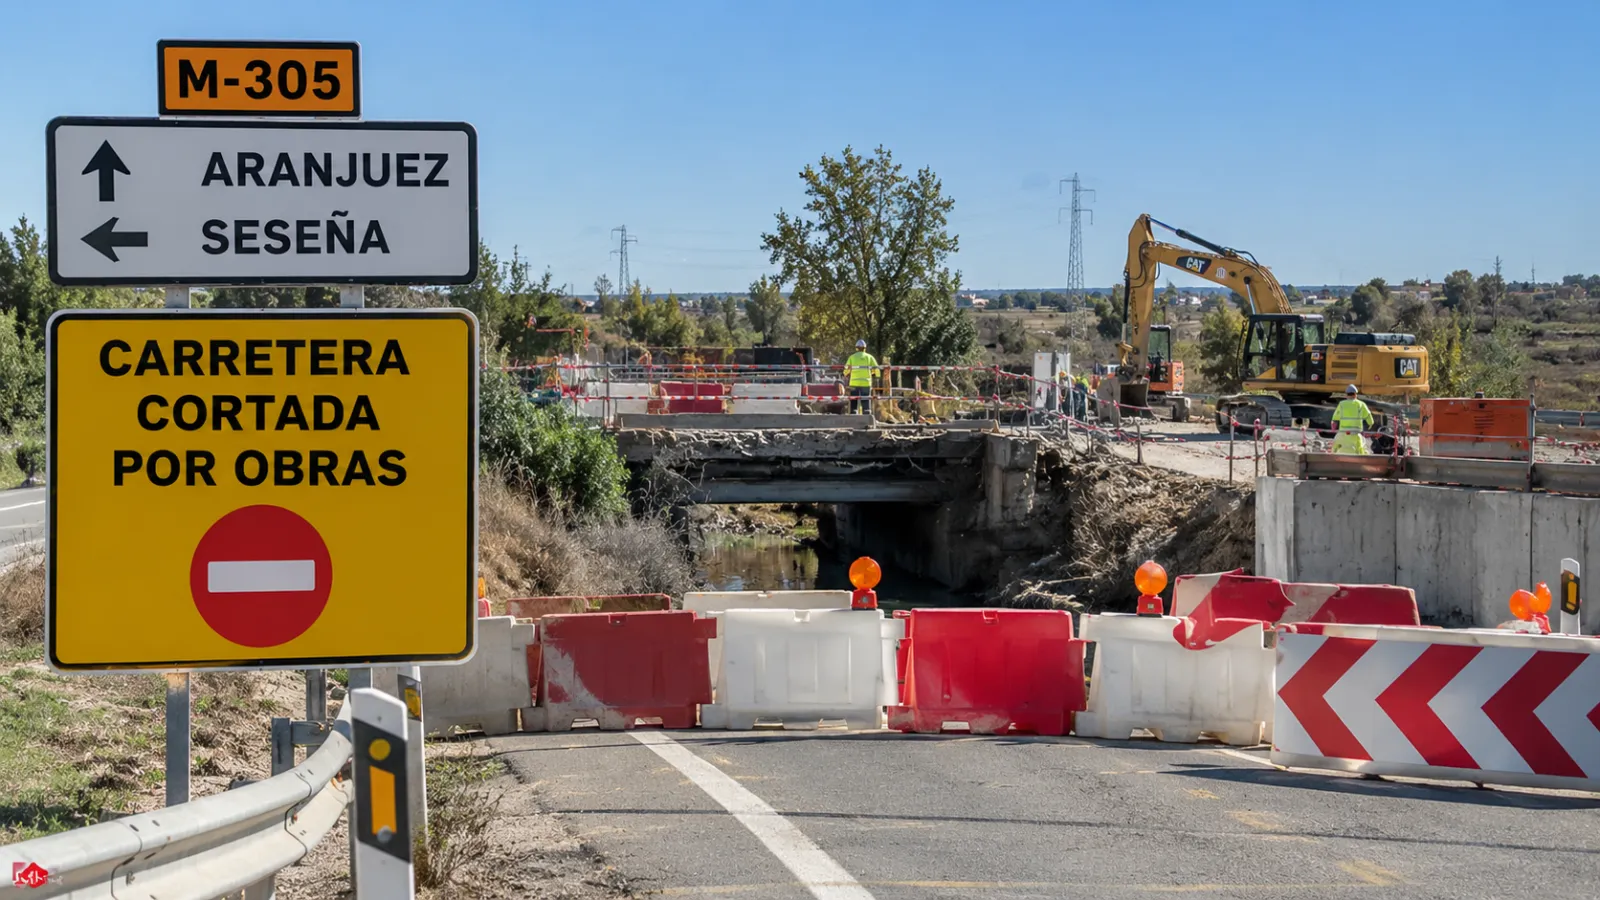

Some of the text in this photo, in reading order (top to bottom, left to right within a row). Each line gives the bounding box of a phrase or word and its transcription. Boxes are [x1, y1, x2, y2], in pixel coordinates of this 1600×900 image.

[178, 58, 341, 102] M-305
[200, 151, 450, 188] ARANJUEZ
[201, 209, 391, 255] SESEÑA
[1186, 257, 1205, 273] CAT
[99, 339, 410, 377] CARRETERA
[1400, 359, 1418, 376] CAT
[137, 394, 381, 432] CORTADA
[113, 449, 407, 487] POR OBRAS
